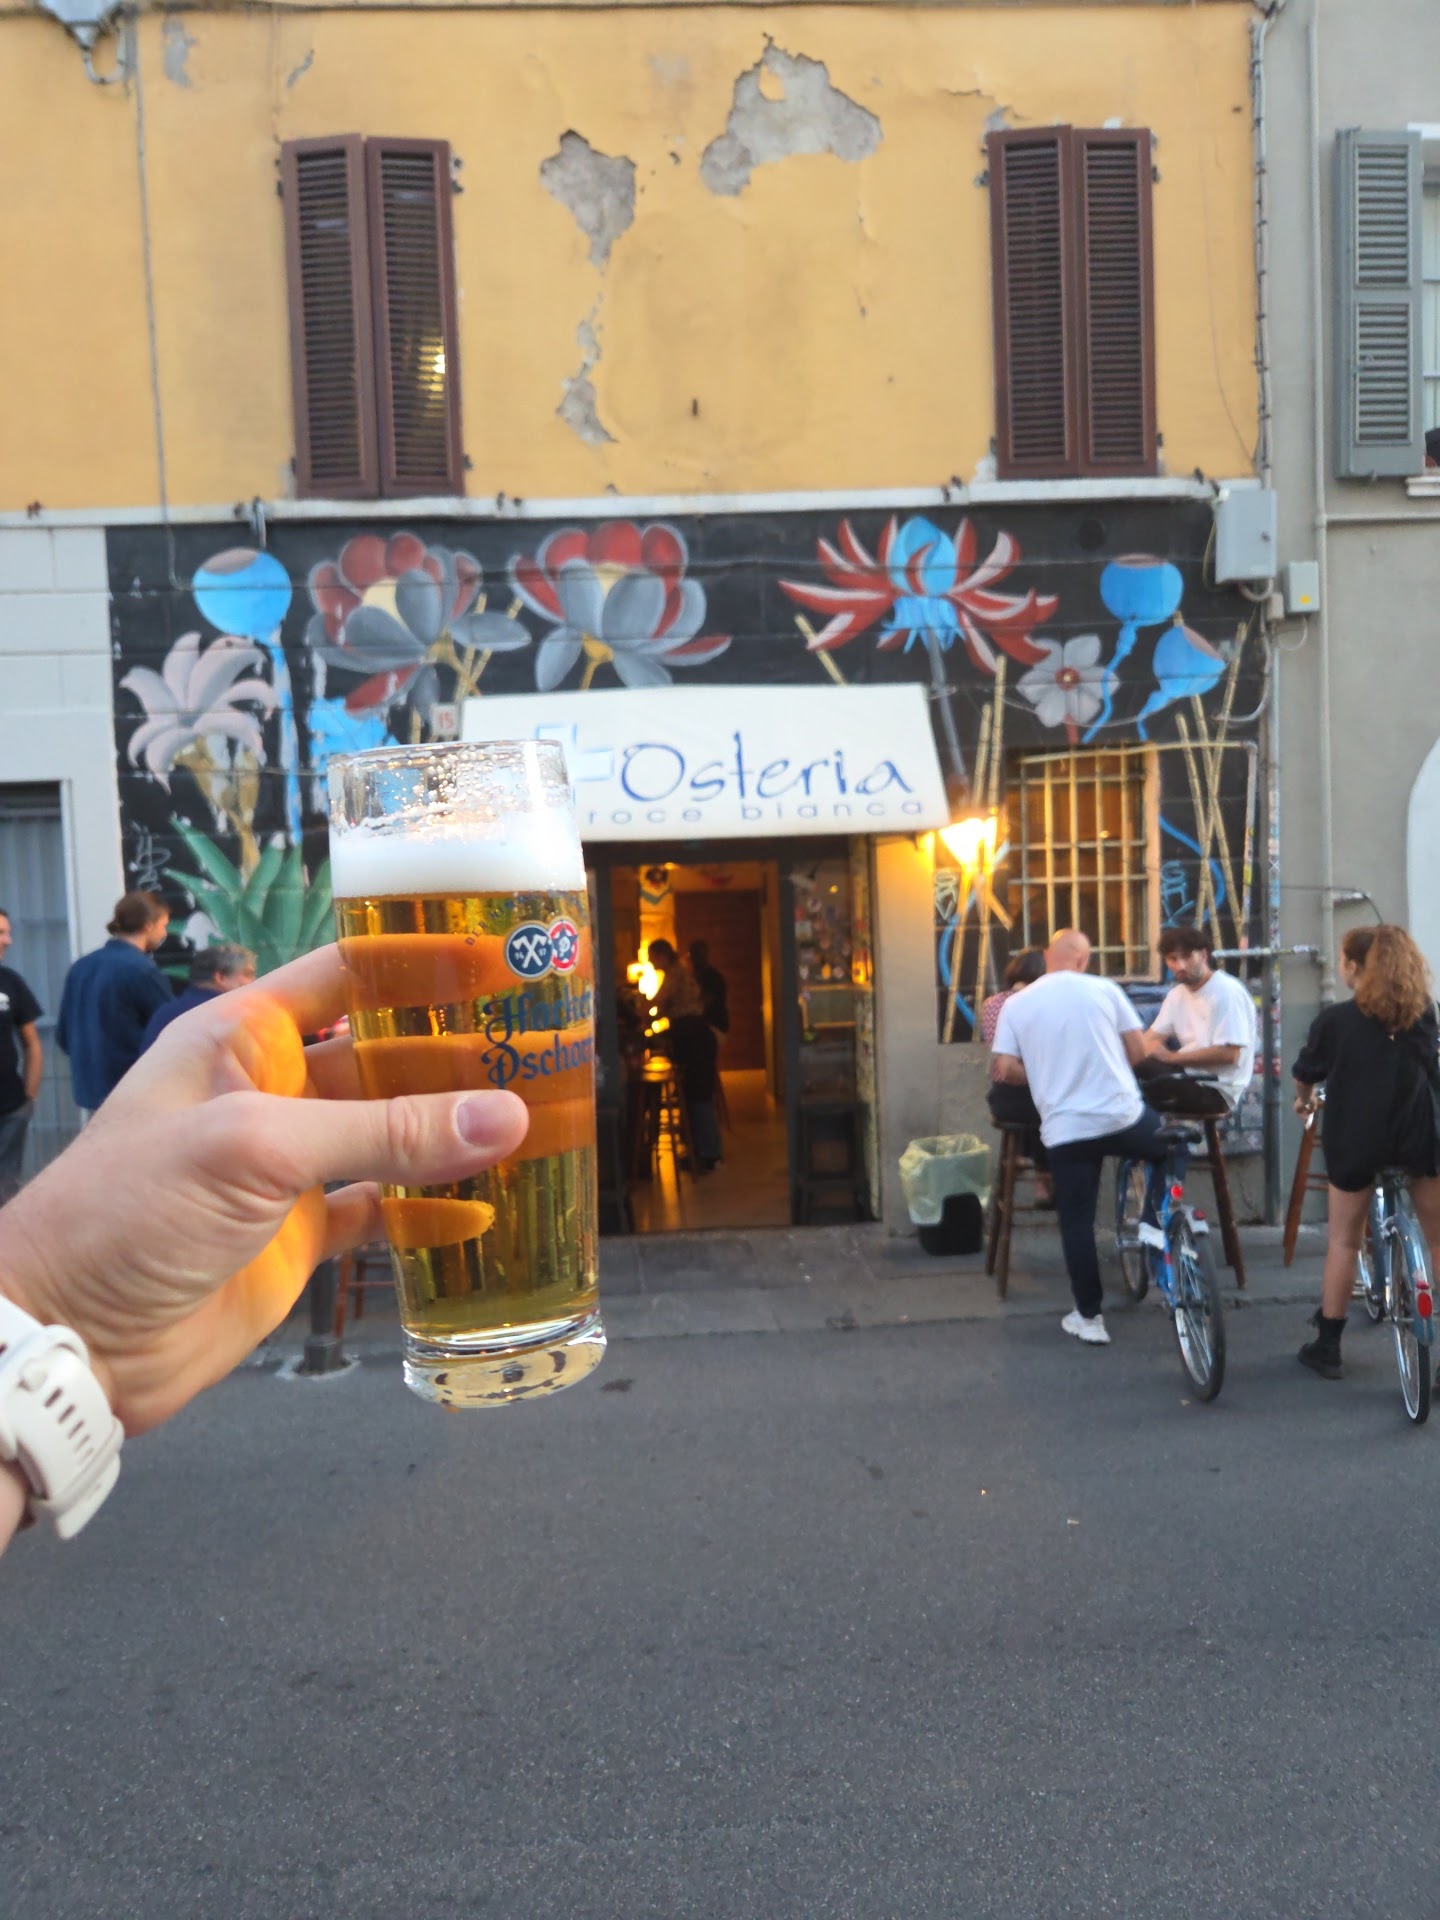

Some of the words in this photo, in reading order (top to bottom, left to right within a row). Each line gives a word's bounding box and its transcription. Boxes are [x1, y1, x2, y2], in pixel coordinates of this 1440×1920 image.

[621, 731, 914, 802] Osteria
[588, 808, 703, 824] roce
[481, 1034, 593, 1090] Pschor
